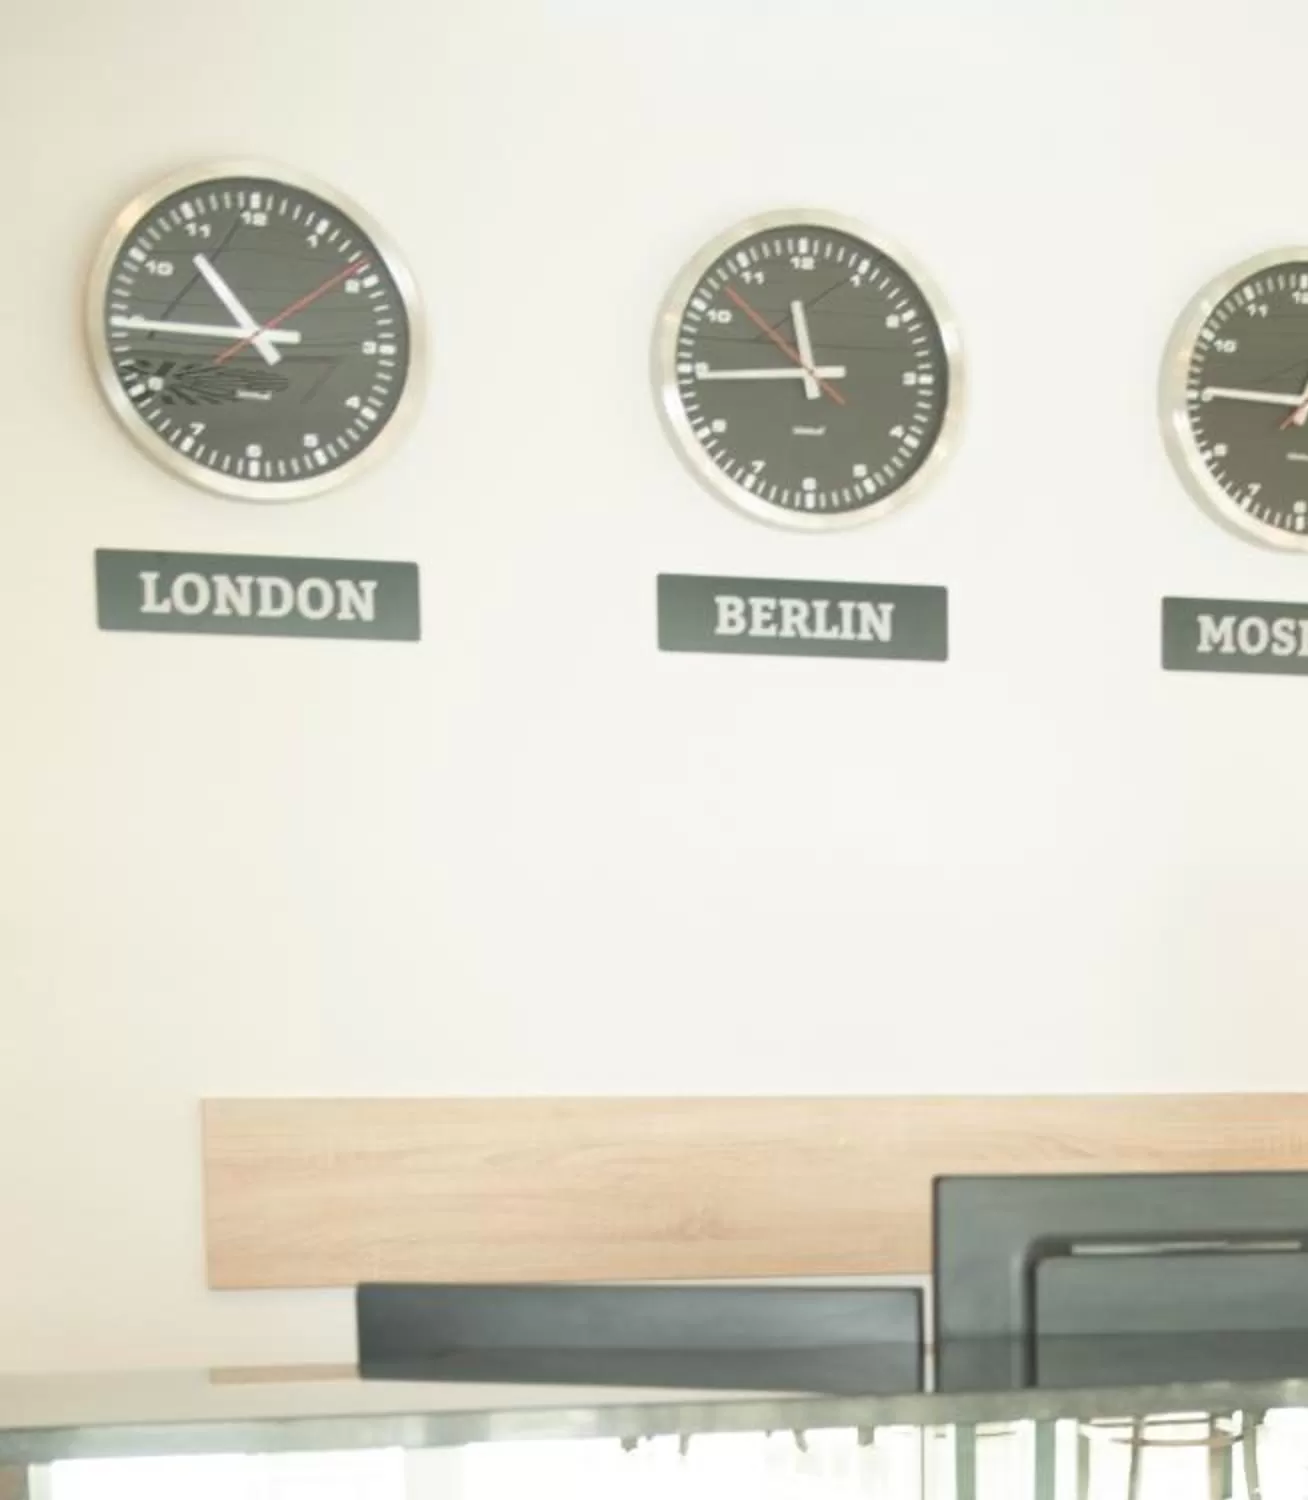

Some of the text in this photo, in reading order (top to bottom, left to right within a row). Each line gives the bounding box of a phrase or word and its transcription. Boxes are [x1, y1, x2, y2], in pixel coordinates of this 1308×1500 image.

[144, 259, 174, 277] 10
[706, 308, 733, 324] 10
[139, 571, 379, 622] LONDON
[714, 595, 895, 642] BERLIN
